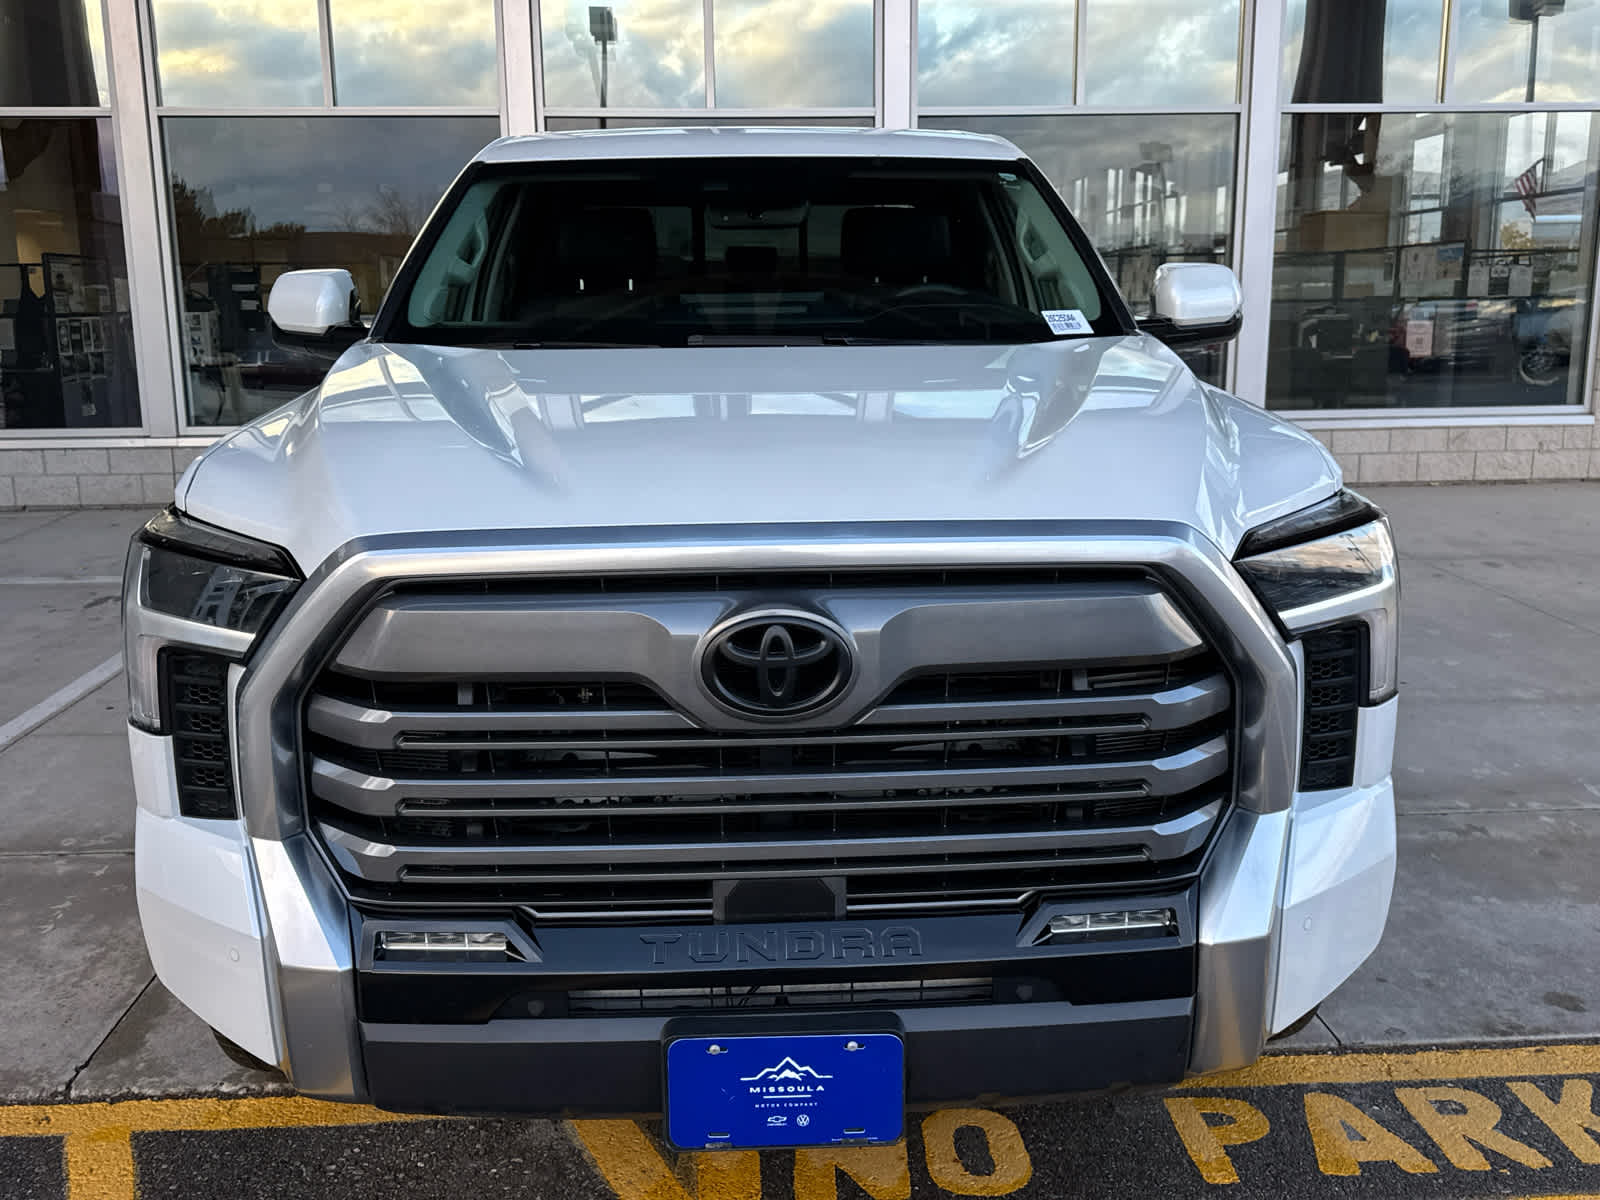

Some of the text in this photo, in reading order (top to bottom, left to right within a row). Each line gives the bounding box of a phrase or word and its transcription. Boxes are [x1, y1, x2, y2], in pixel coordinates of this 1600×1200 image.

[639, 925, 922, 965] TUNDRA
[749, 1085, 825, 1093] MISSOULA
[794, 1107, 1033, 1200] NO
[1164, 1079, 1600, 1185] PARK
